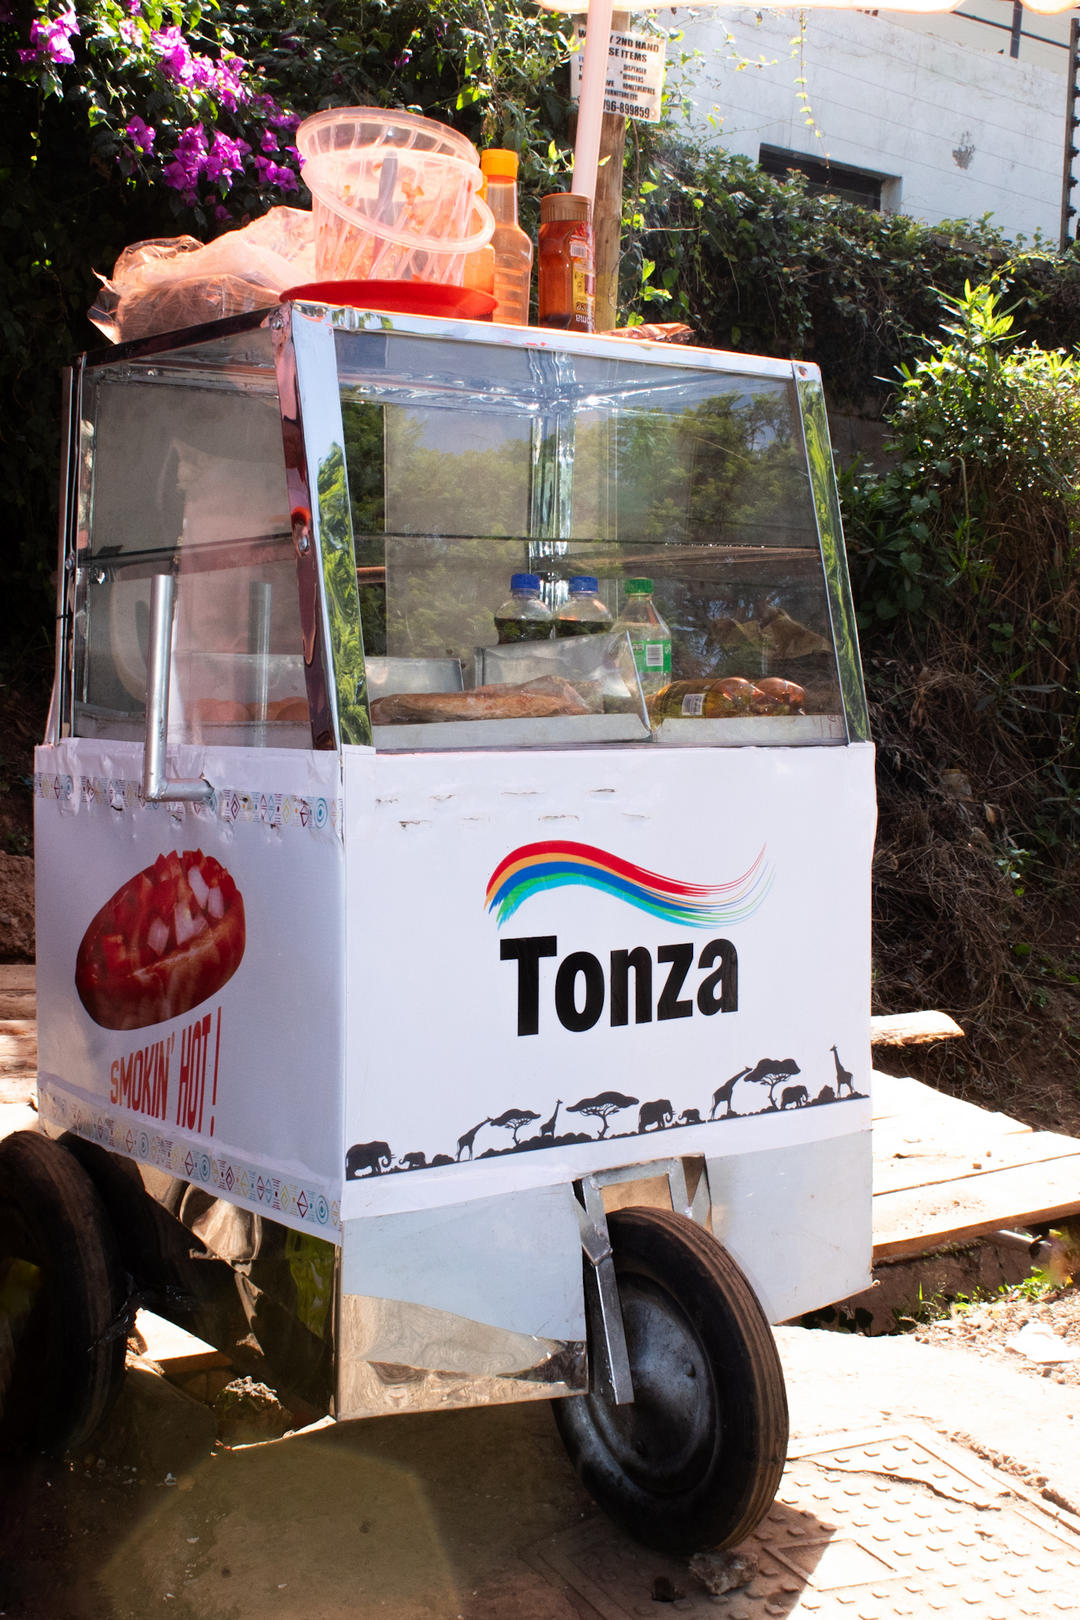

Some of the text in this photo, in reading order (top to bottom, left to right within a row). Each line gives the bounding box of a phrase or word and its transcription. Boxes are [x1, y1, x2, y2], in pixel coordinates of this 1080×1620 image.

[615, 35, 634, 48] 2ND
[635, 39, 660, 53] HAND
[621, 49, 648, 63] ITEMS
[500, 935, 739, 1037] Tonza
[109, 1031, 175, 1121] SMOKIN'
